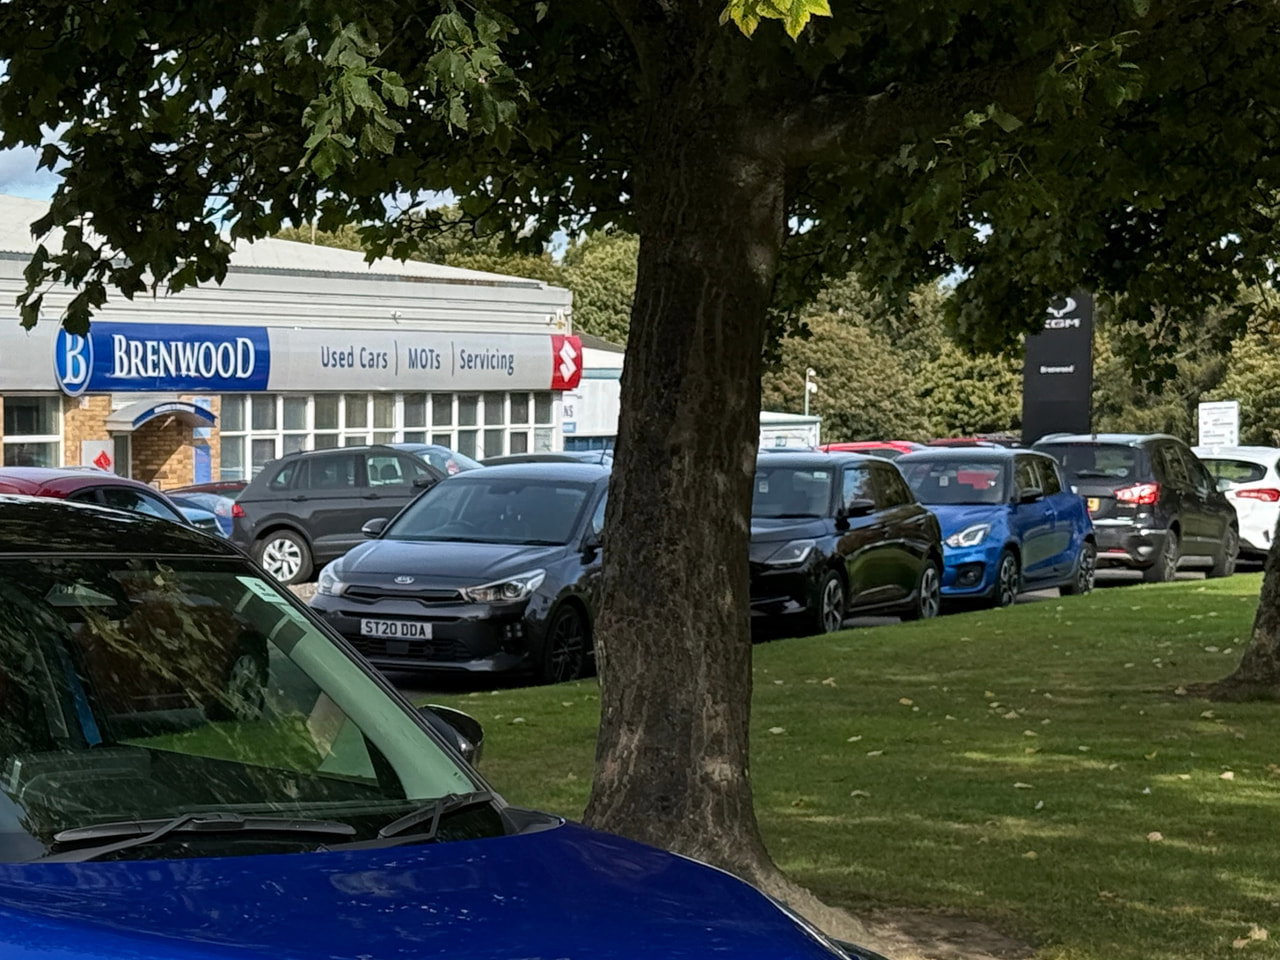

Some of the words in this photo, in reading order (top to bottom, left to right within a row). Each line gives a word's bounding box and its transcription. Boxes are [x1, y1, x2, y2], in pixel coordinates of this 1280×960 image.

[112, 334, 256, 379] BRENWOOD
[321, 345, 354, 369] Used
[359, 346, 388, 370] Cars
[408, 348, 441, 370] MOTs
[459, 348, 515, 377] Servicing
[365, 620, 397, 636] ST20
[401, 623, 426, 637] DDA
